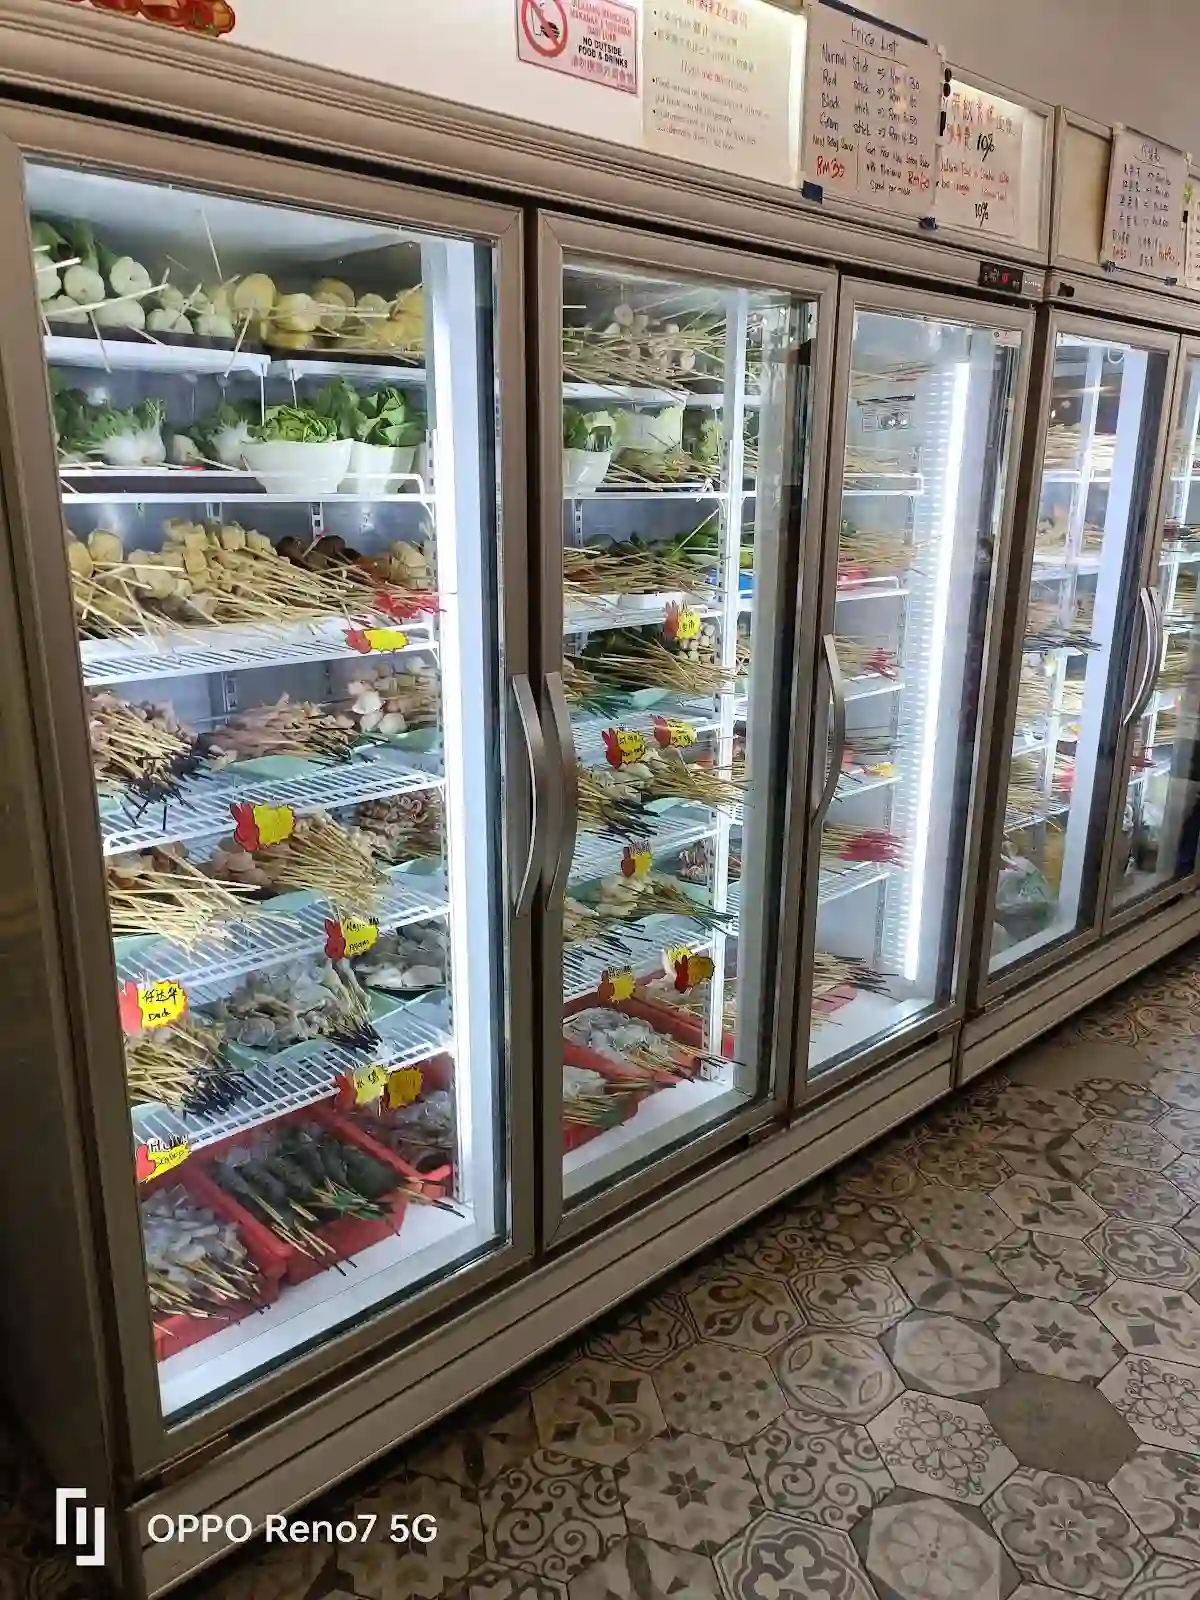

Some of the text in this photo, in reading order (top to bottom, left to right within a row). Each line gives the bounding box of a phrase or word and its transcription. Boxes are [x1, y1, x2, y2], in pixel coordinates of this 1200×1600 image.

[582, 36, 622, 57] NO OUTSIDE
[851, 21, 899, 56] Price List
[578, 45, 596, 58] FOOD
[604, 53, 628, 68] DRINKS
[821, 42, 847, 69] Normal
[823, 69, 837, 86] Red
[976, 132, 996, 162] 10%
[974, 201, 989, 227] 10%
